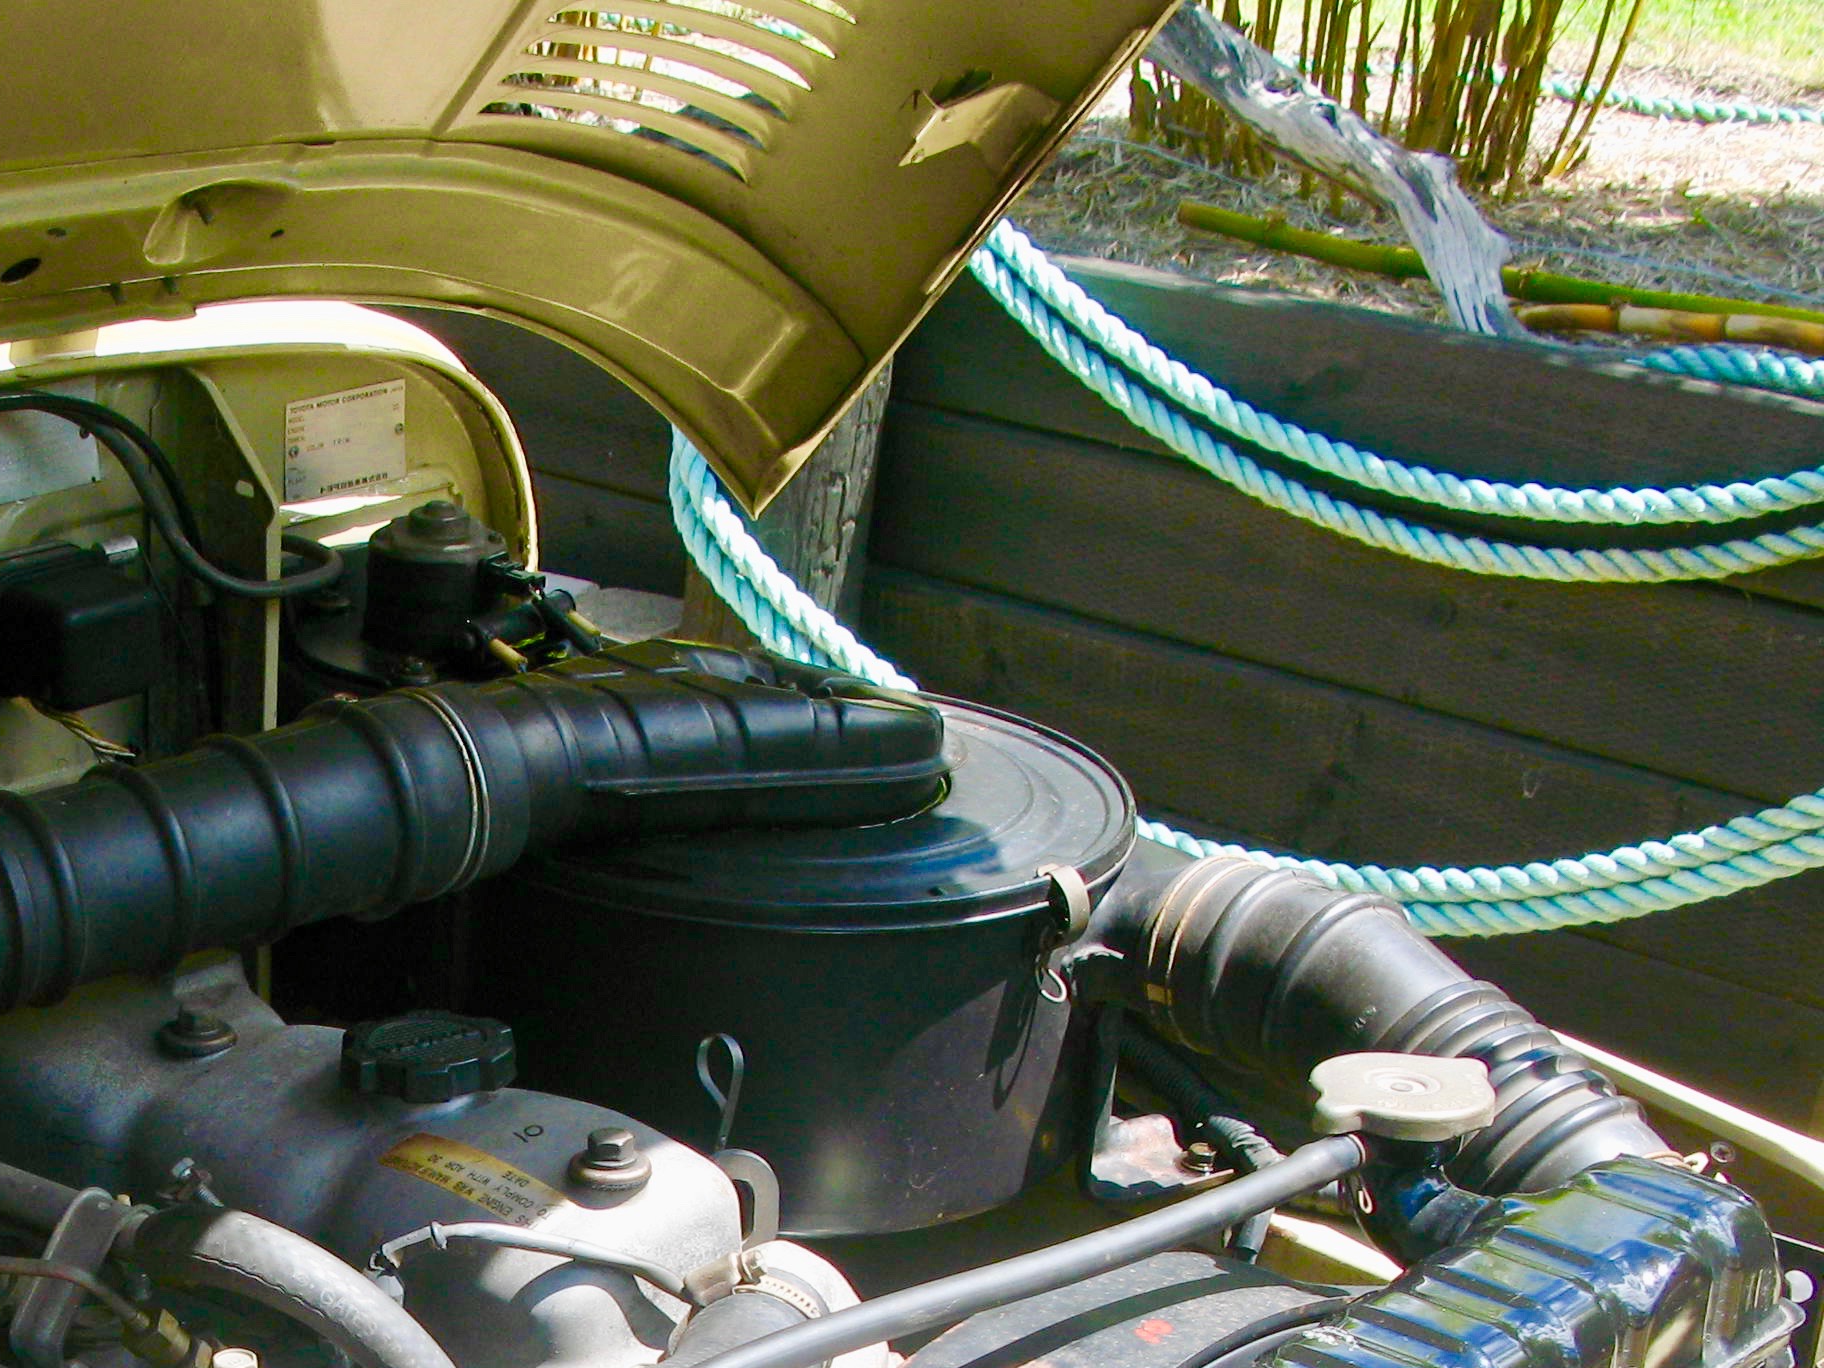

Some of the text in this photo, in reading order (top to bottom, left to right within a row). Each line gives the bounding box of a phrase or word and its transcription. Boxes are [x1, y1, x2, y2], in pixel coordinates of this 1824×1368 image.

[316, 397, 340, 409] MOTOR
[341, 387, 388, 404] CORPORATION
[466, 1171, 491, 1186] WITH
[501, 1169, 531, 1188] DATE
[495, 1184, 535, 1209] COMPLY
